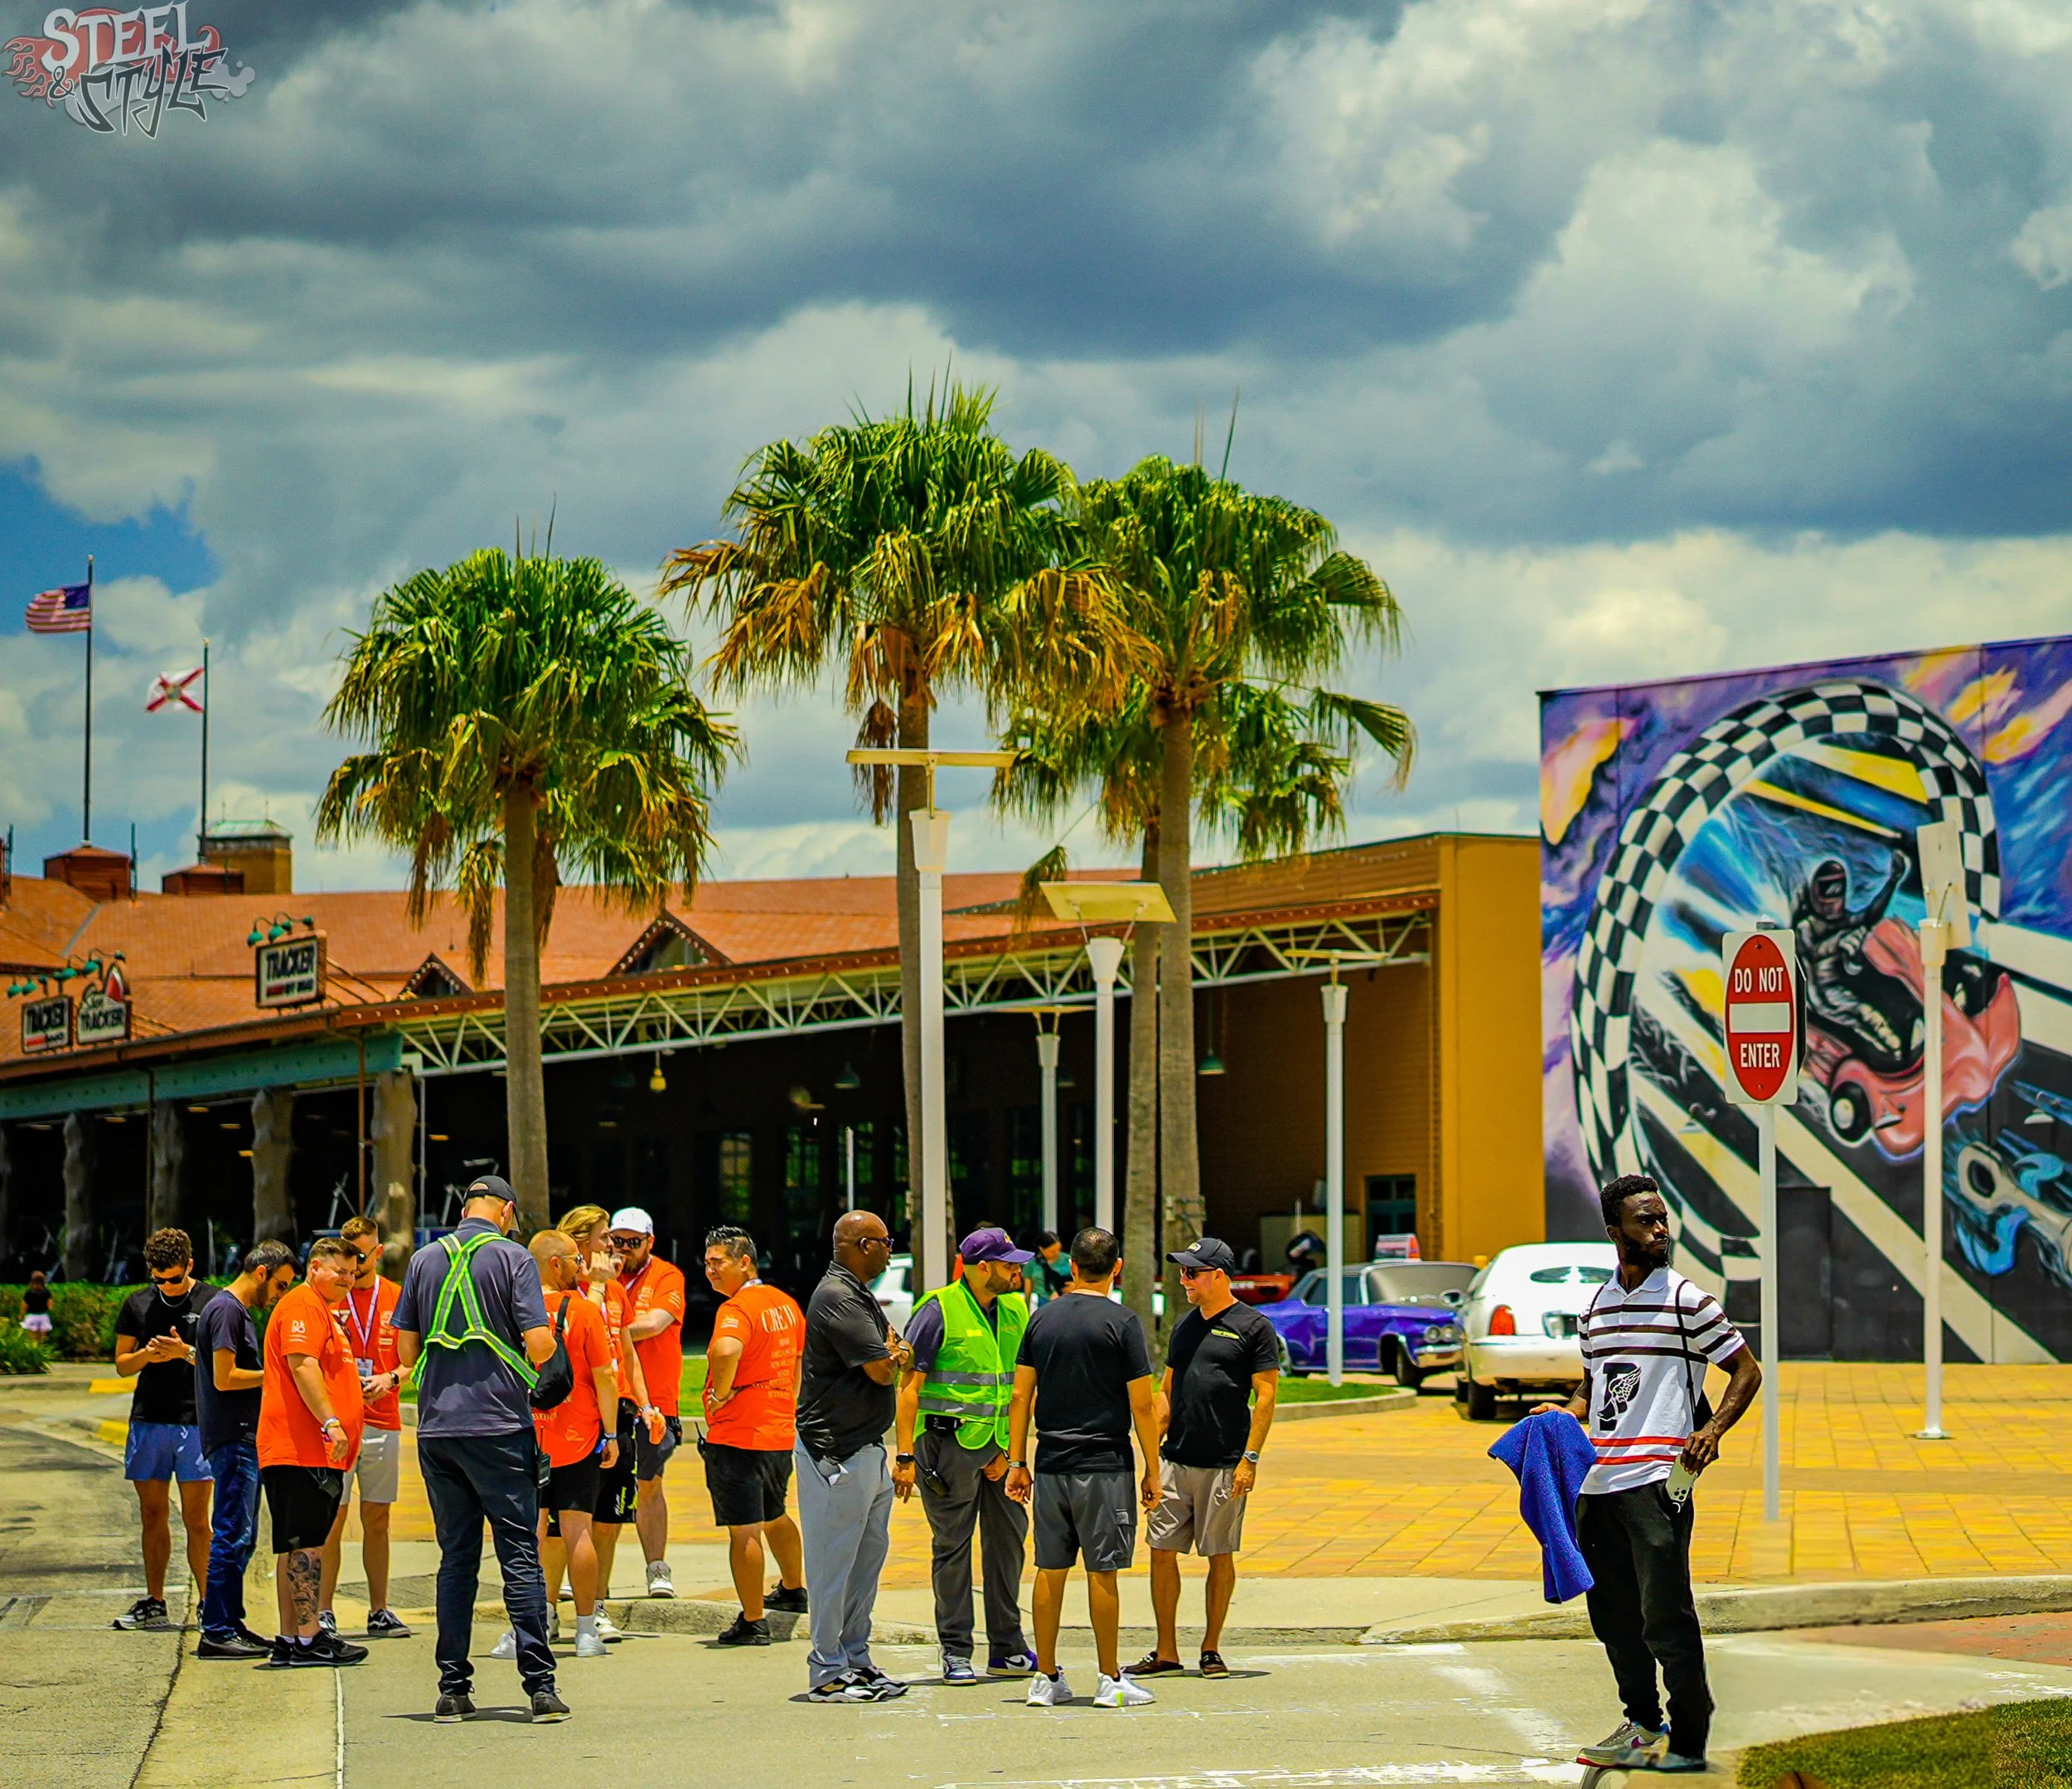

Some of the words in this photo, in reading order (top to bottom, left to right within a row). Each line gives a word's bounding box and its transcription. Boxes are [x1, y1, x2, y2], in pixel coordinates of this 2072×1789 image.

[266, 943, 314, 981] TRACKER
[1734, 968, 1752, 993] DO
[1759, 967, 1784, 992] NOT
[1740, 1043, 1781, 1068] ENTER
[761, 1304, 796, 1334] CREW
